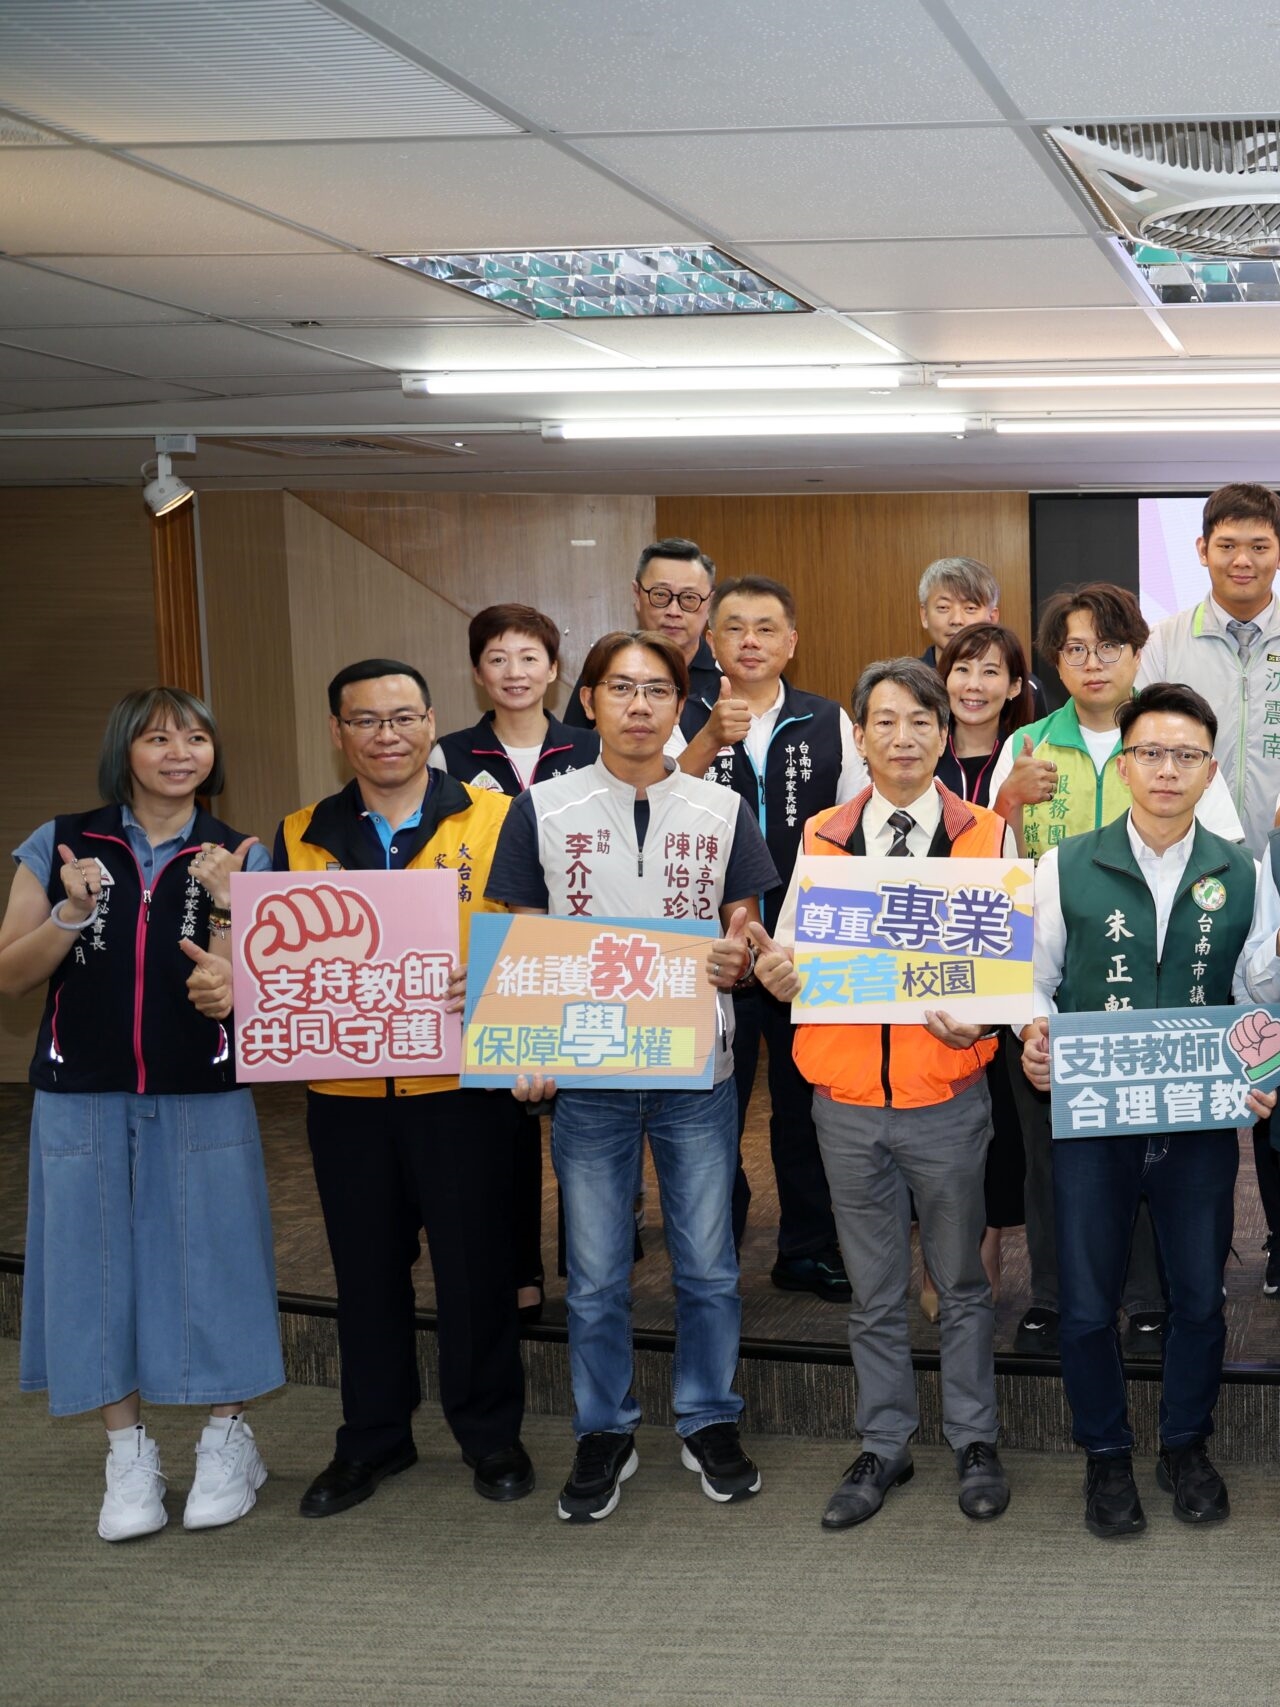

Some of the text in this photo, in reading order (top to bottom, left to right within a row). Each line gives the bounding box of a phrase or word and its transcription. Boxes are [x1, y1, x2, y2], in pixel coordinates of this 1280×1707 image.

[720, 757, 733, 789] 副公
[785, 744, 797, 827] 中小學家長協會
[799, 741, 813, 782] 台南市
[597, 829, 611, 855] 特助
[457, 843, 473, 902] 大台南
[565, 832, 593, 917] 李介文
[662, 832, 691, 919] 陳怡珍
[799, 883, 1010, 954] 尊重專業
[261, 955, 451, 1010] 支持教師
[497, 933, 698, 1001] 維護教權
[799, 953, 976, 1007] 友善校園
[1189, 913, 1213, 1005] 台南市議
[245, 1012, 439, 1061] 共同守護
[473, 1001, 673, 1067] 保障學權
[1060, 1032, 1220, 1080] 支持教師
[1067, 1079, 1251, 1130] 合理管教
